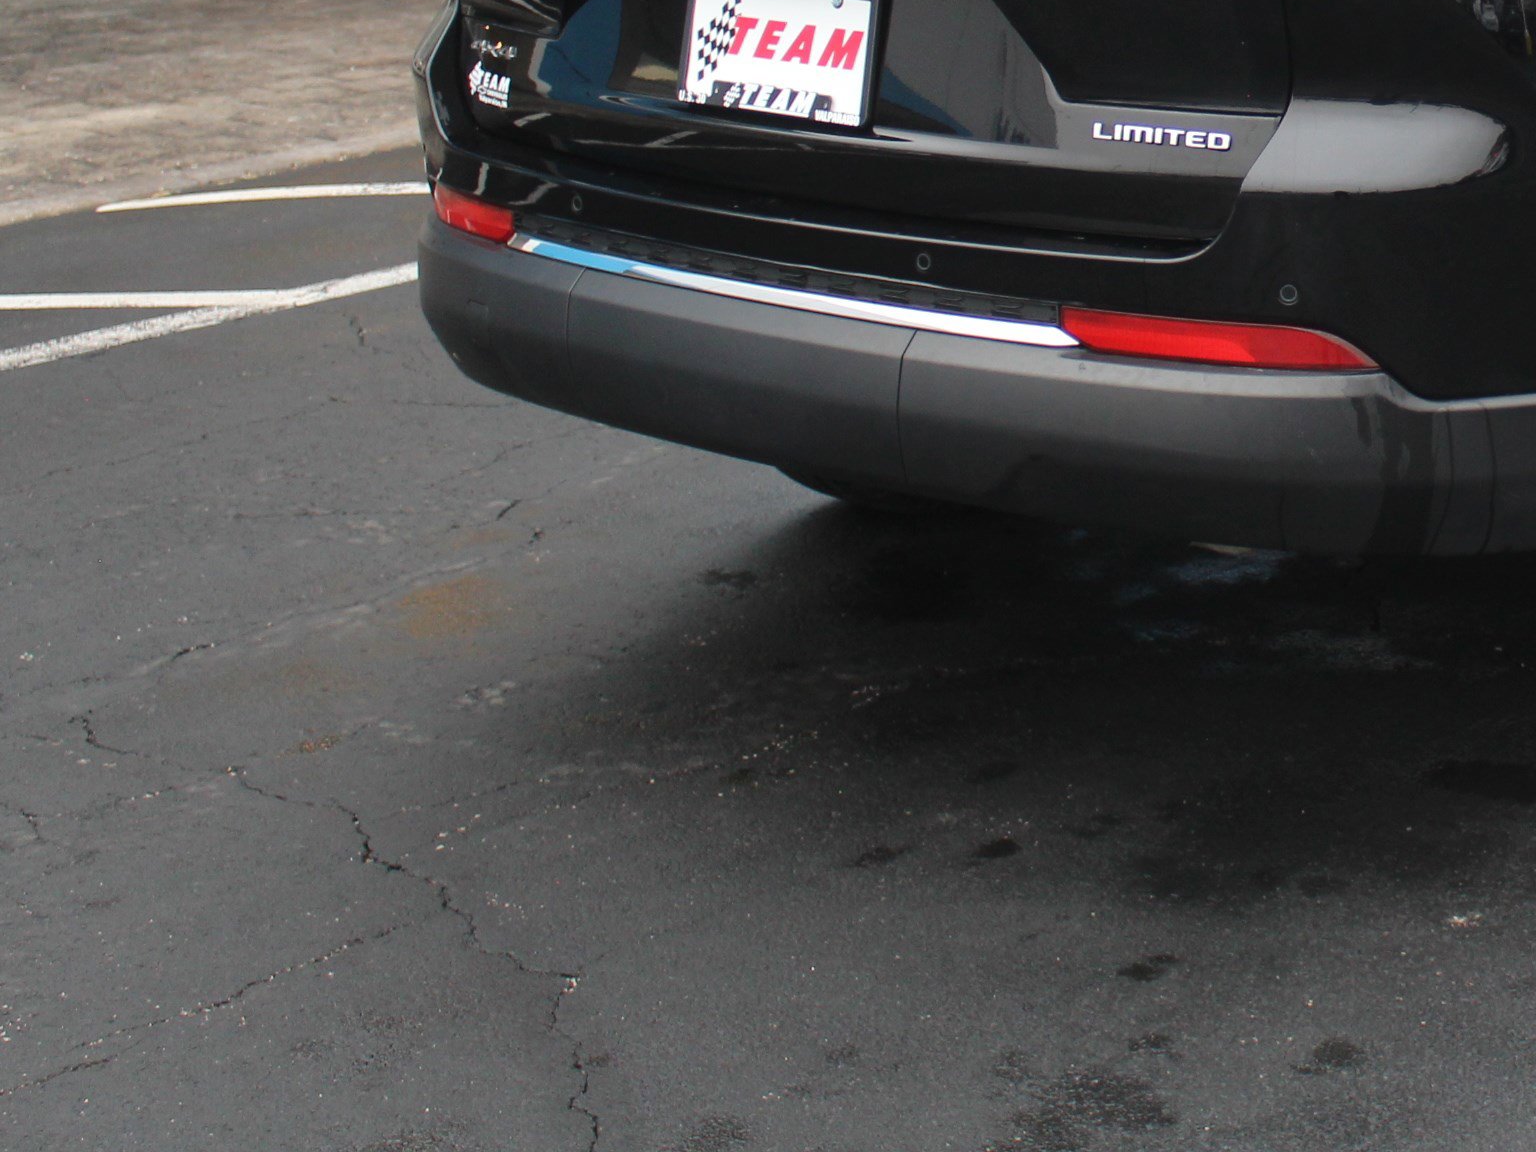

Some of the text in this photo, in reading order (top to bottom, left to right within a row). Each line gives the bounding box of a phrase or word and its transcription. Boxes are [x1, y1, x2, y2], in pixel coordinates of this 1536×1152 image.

[728, 15, 865, 70] TEAM
[739, 82, 818, 116] TEAM
[1092, 122, 1231, 151] LIMITED
